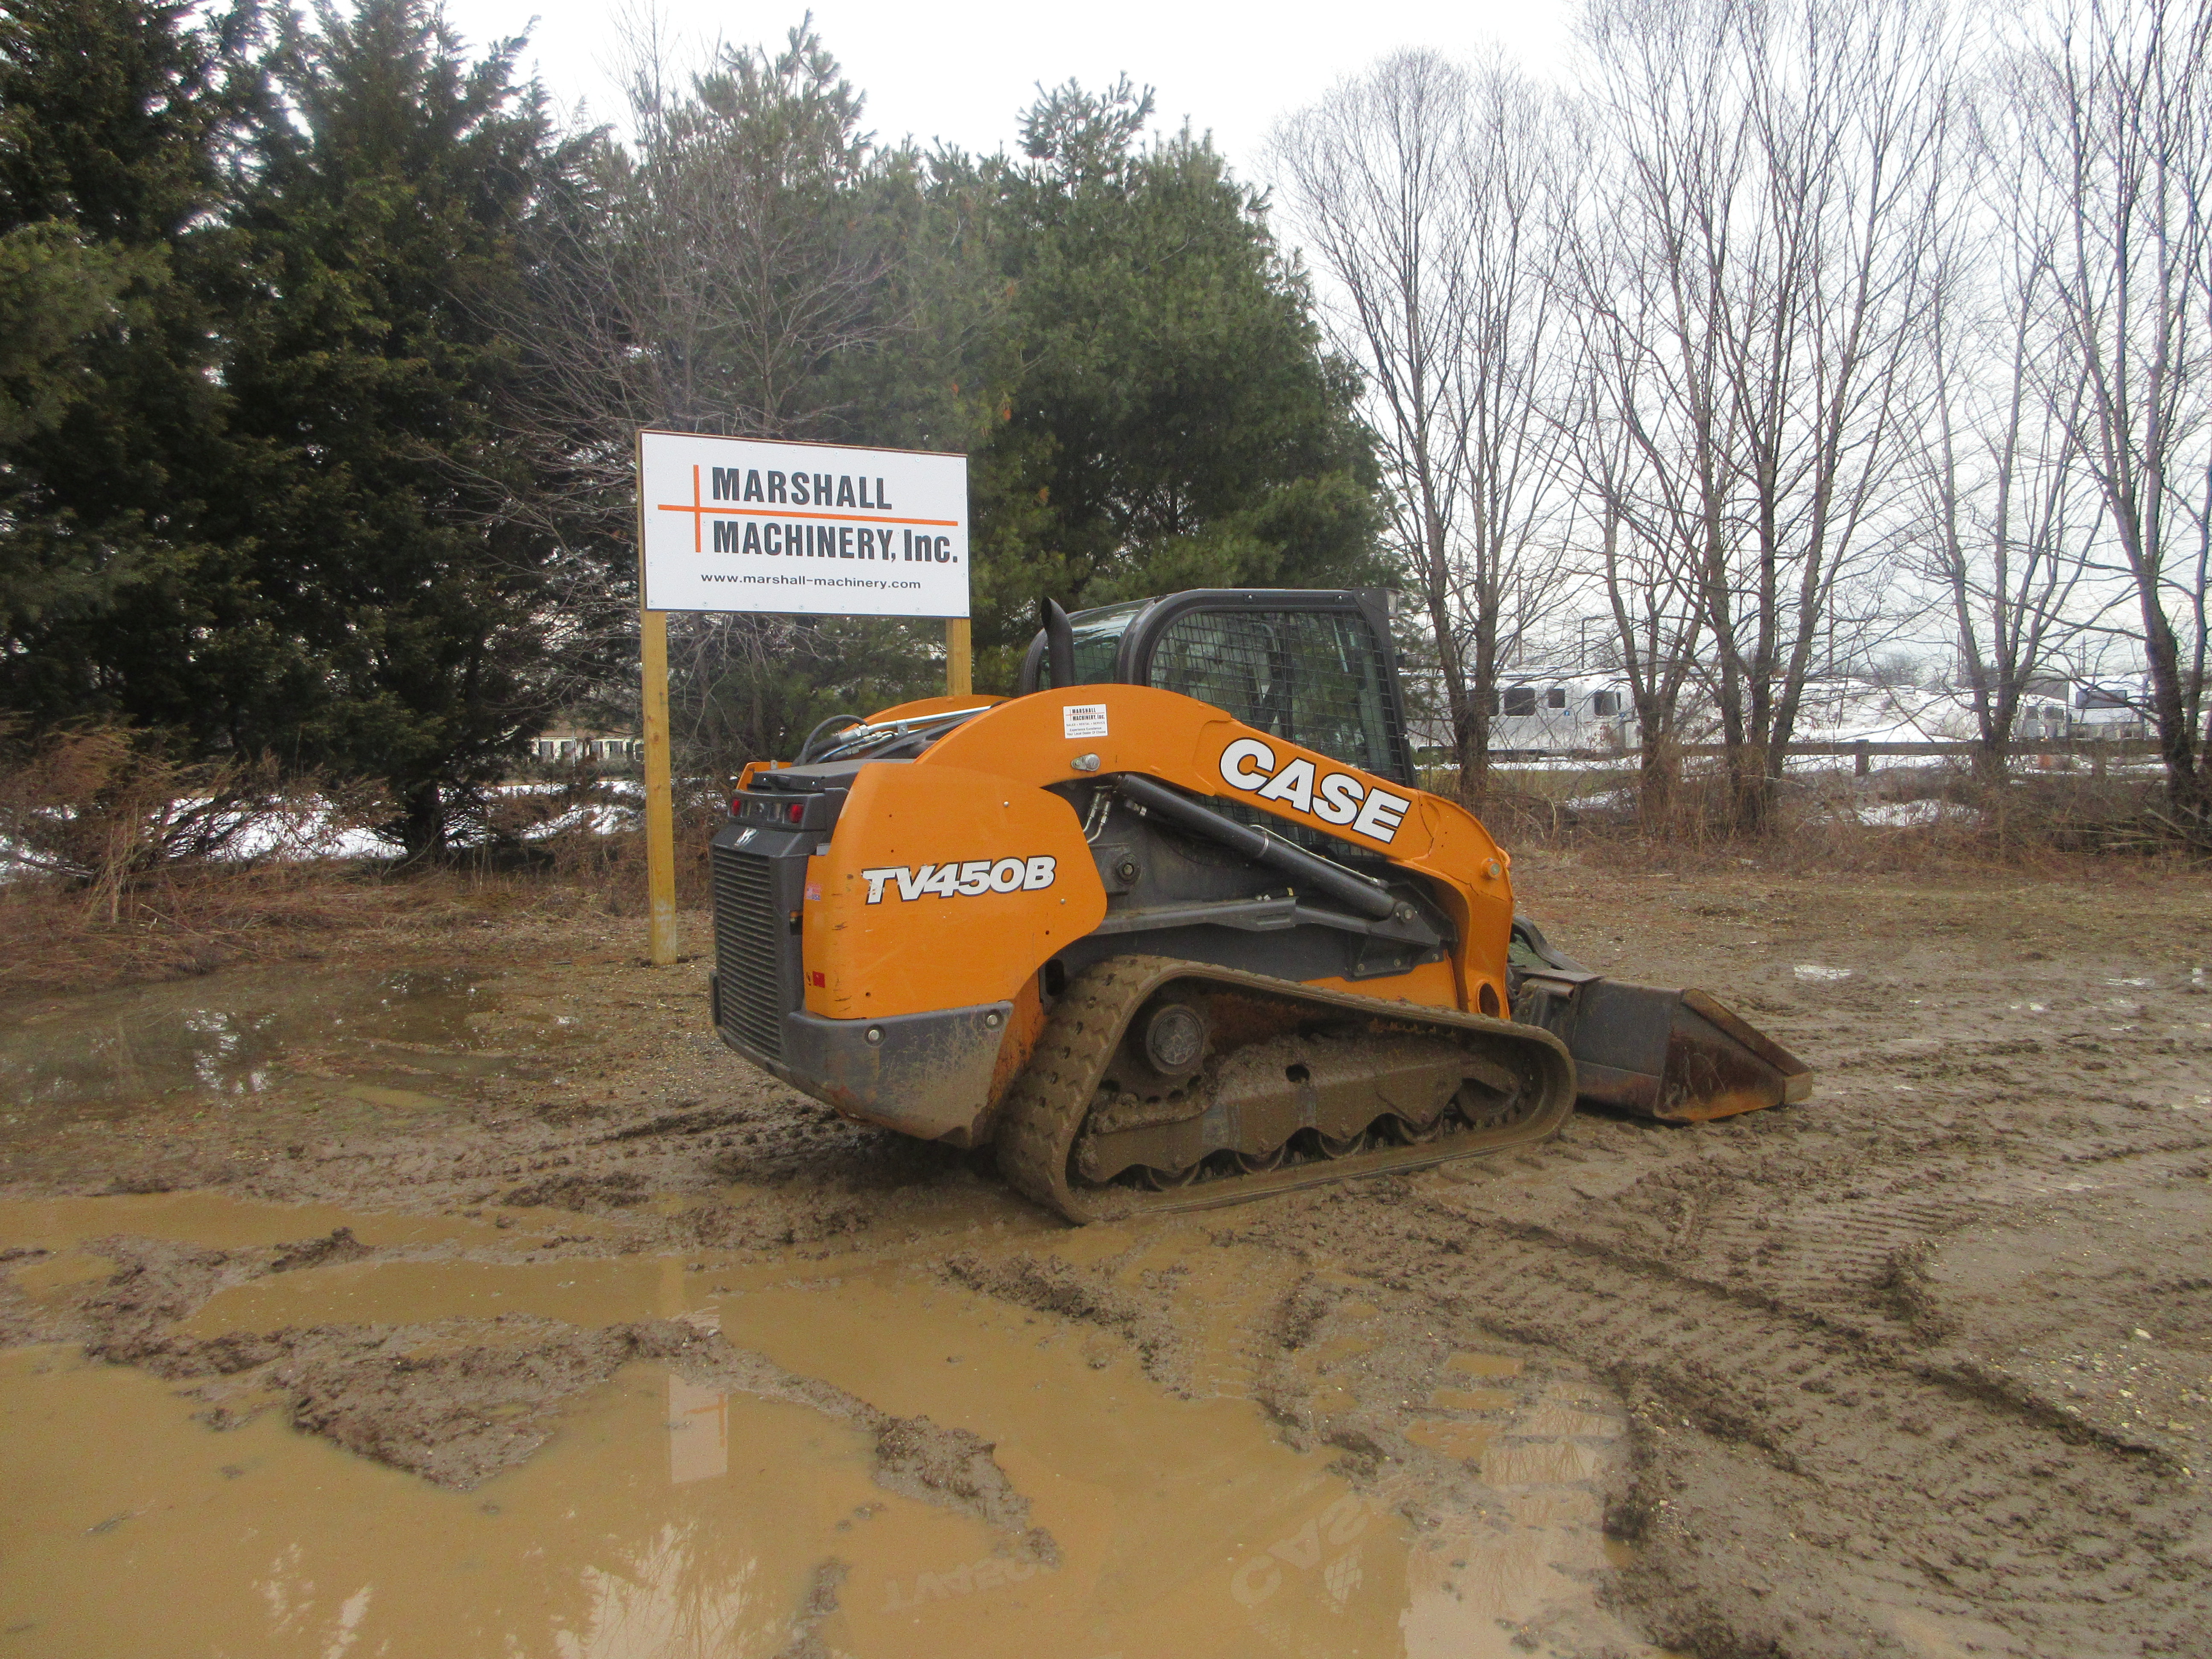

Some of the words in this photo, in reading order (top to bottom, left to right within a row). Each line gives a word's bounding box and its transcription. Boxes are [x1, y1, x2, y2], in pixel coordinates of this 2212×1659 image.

[711, 466, 892, 510] MARSHALL
[713, 520, 896, 563] MACHINERY,
[904, 529, 958, 563] Inc.
[701, 573, 921, 589] www.marshall-machinery.com
[1219, 737, 1412, 844] CASE
[861, 856, 1056, 905] TV450B
